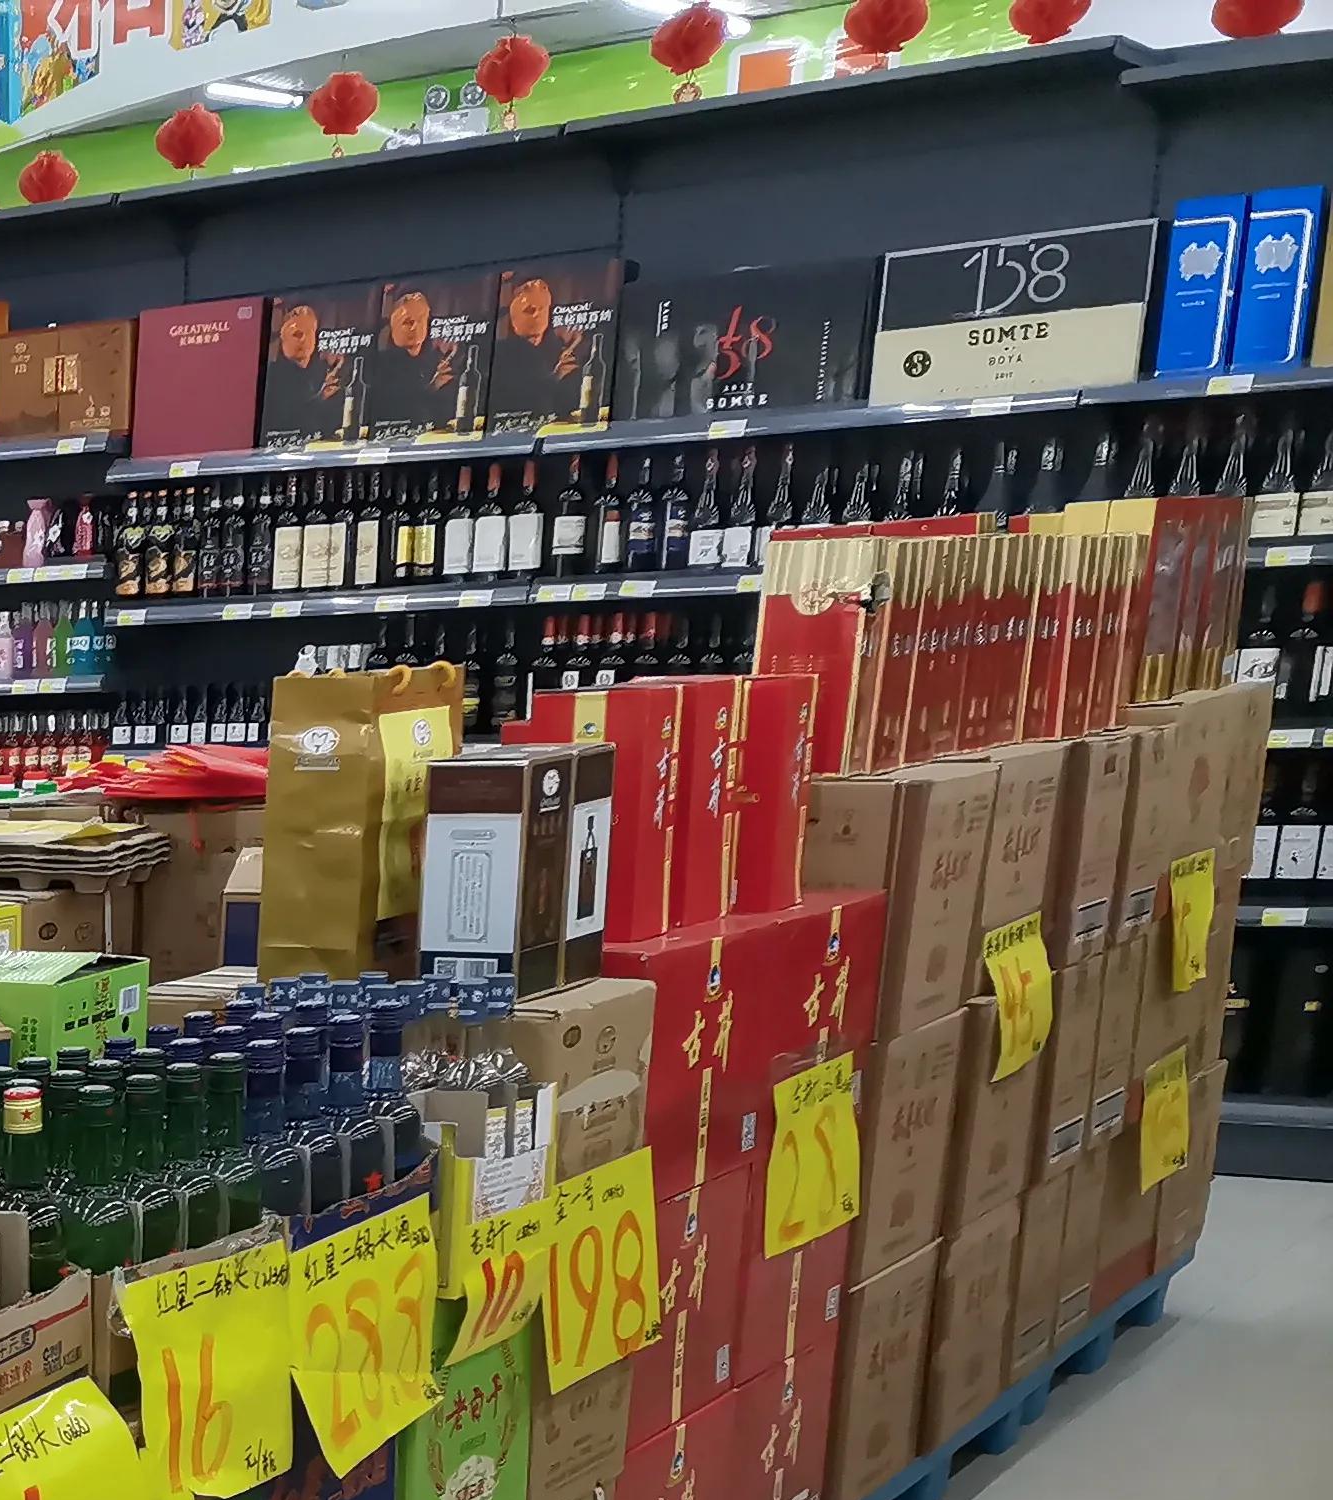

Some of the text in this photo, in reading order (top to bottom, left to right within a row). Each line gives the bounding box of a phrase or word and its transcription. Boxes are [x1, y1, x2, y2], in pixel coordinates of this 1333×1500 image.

[169, 321, 230, 337] GREATWALL
[967, 320, 1052, 347] SOMTE
[549, 1210, 645, 1369] 198
[163, 1333, 232, 1494] 16
